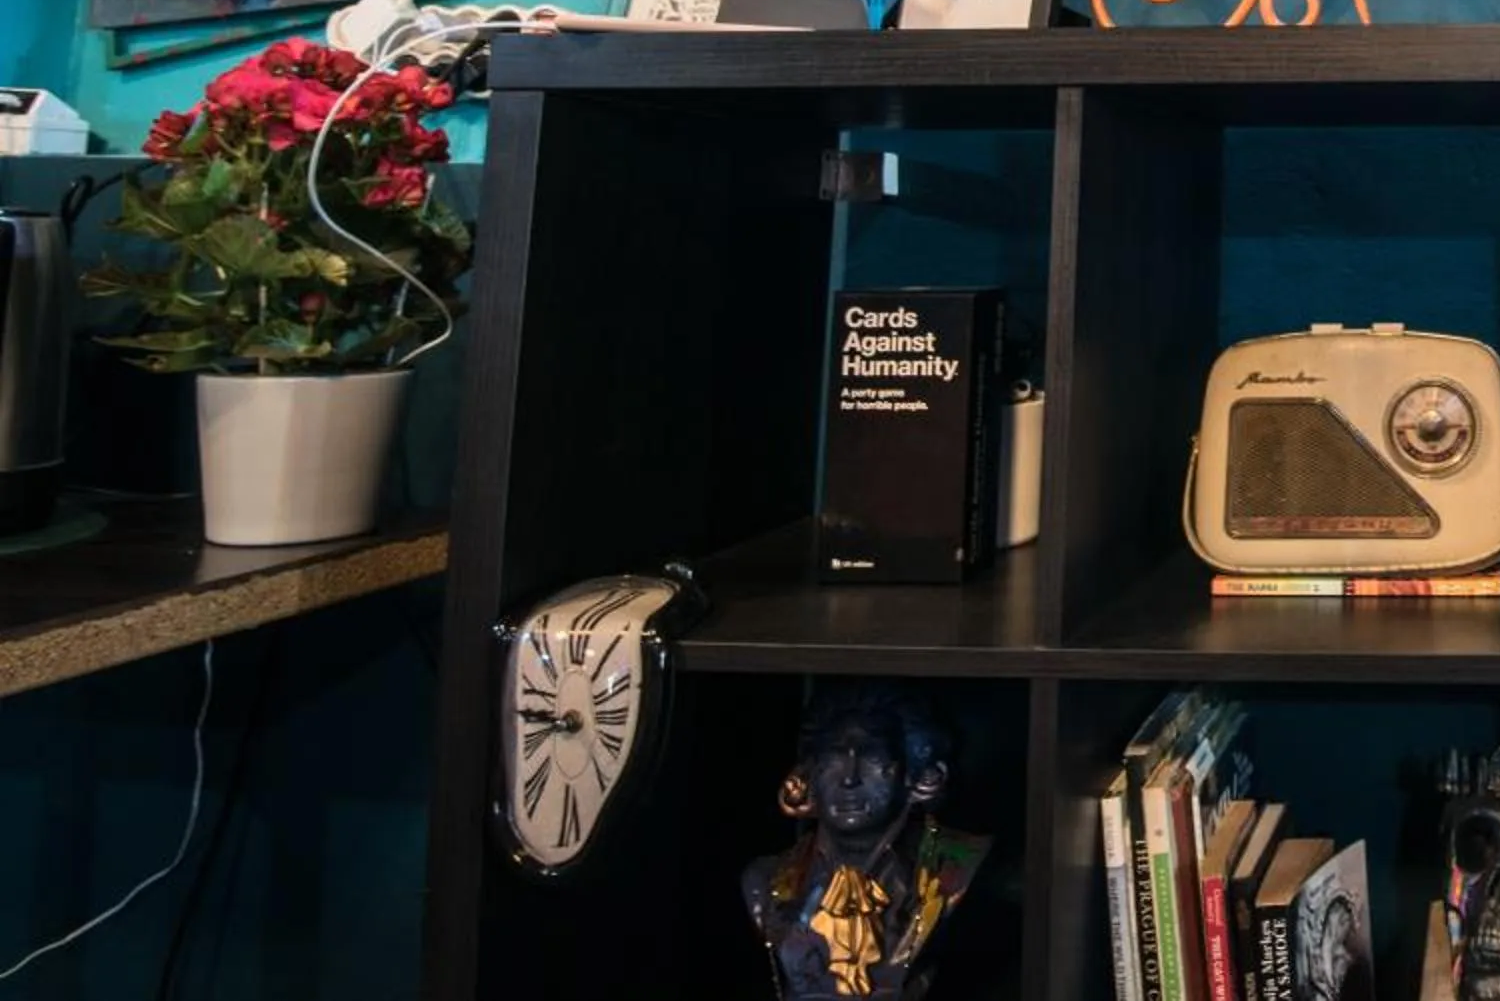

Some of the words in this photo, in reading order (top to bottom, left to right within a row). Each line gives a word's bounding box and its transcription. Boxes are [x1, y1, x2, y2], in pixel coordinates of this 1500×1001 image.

[845, 306, 918, 328] Cards
[843, 331, 936, 356] Against
[841, 356, 957, 381] Humanity
[841, 387, 849, 397] A
[851, 388, 877, 399] party
[878, 389, 905, 399] game
[841, 401, 855, 410] for
[856, 401, 893, 410] horrible
[1138, 880, 1158, 954] PRAGUE
